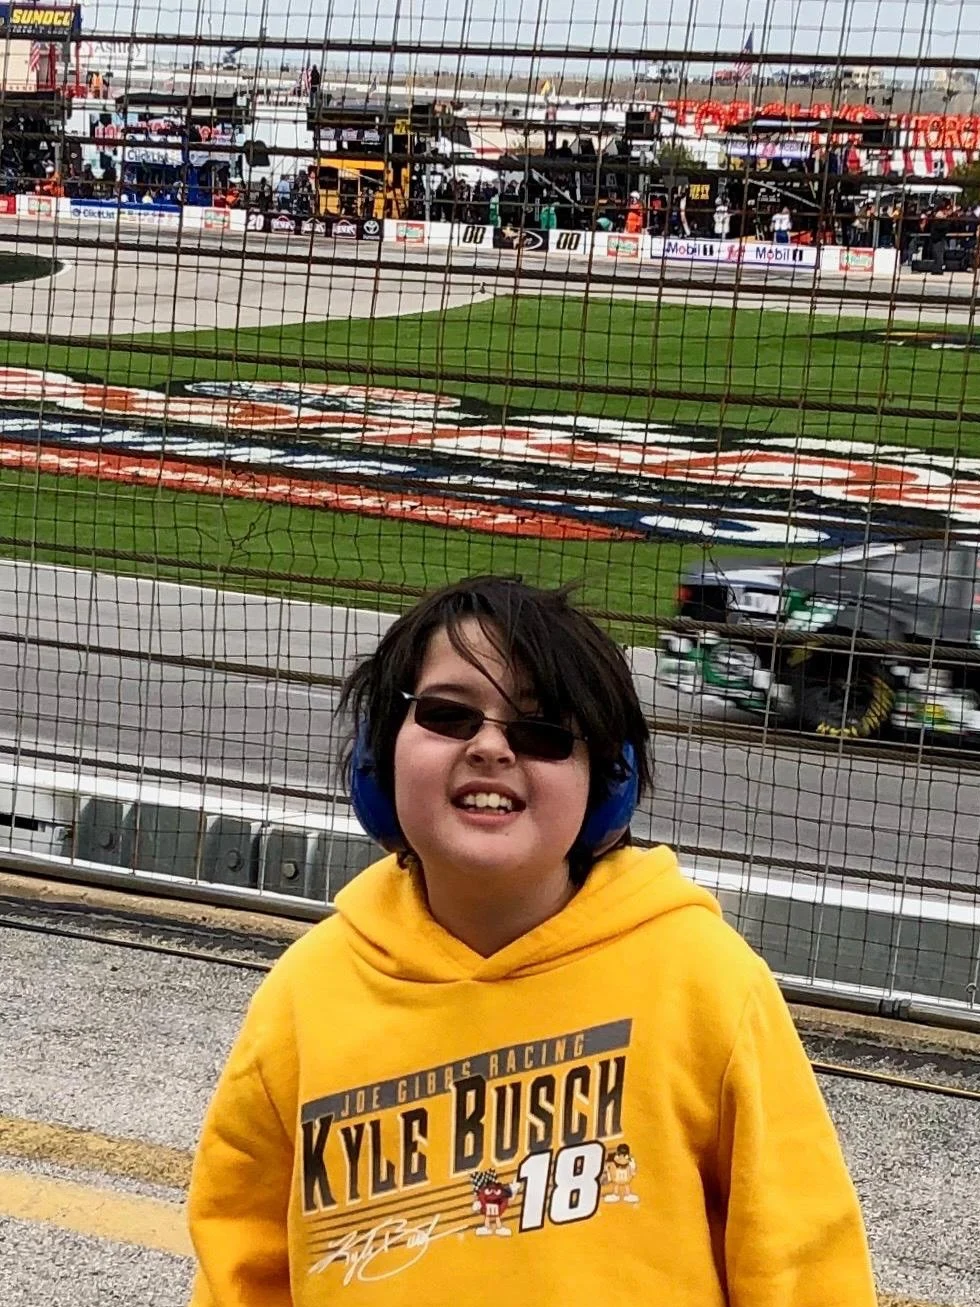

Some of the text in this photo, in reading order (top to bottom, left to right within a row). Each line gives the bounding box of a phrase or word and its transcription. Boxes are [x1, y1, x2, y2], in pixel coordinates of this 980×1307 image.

[247, 213, 265, 231] 20
[462, 225, 487, 244] 00
[556, 232, 581, 251] 00
[666, 241, 701, 258] Mobil
[755, 246, 790, 262] Mobil
[340, 1034, 585, 1117] JOE GIBBS RACING
[301, 1056, 627, 1216] KYLE BUSCH
[518, 1139, 606, 1234] 18
